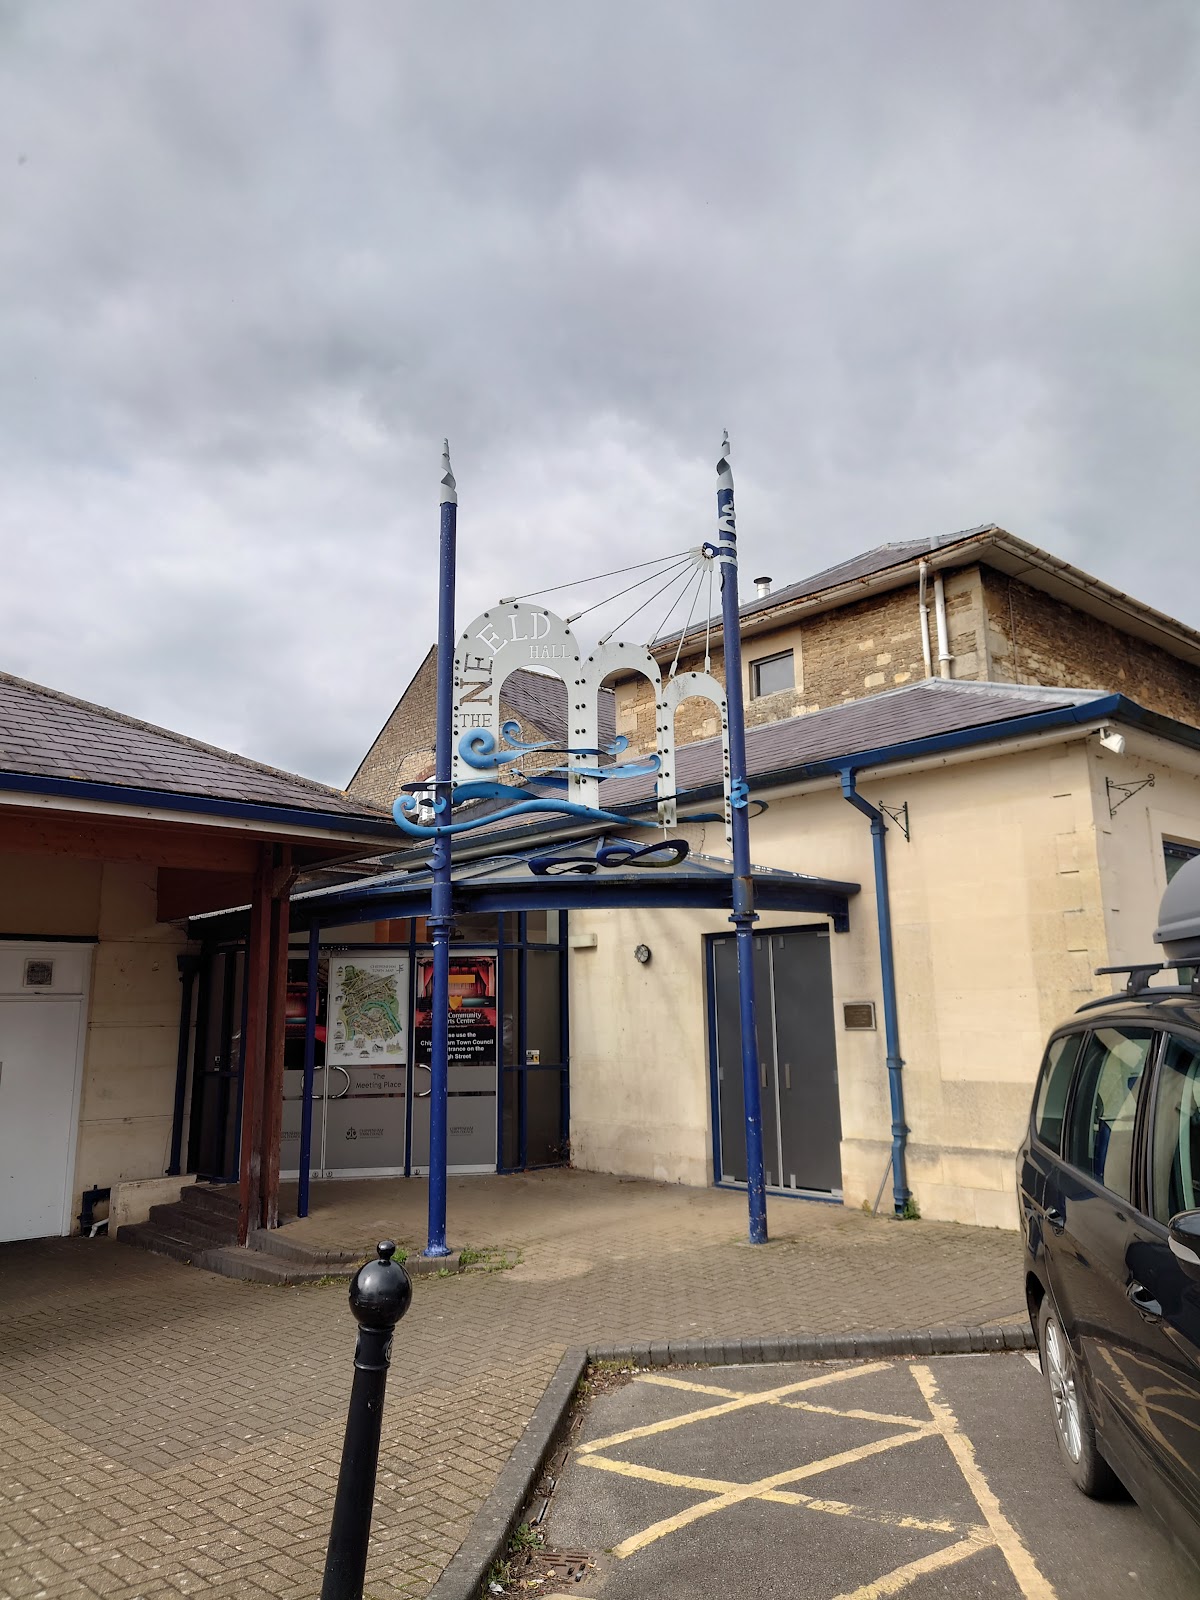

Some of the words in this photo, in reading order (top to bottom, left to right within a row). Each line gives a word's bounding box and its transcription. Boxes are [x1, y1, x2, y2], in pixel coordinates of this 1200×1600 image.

[460, 612, 551, 706] NEELD
[529, 644, 571, 659] HALL
[459, 713, 493, 728] THE
